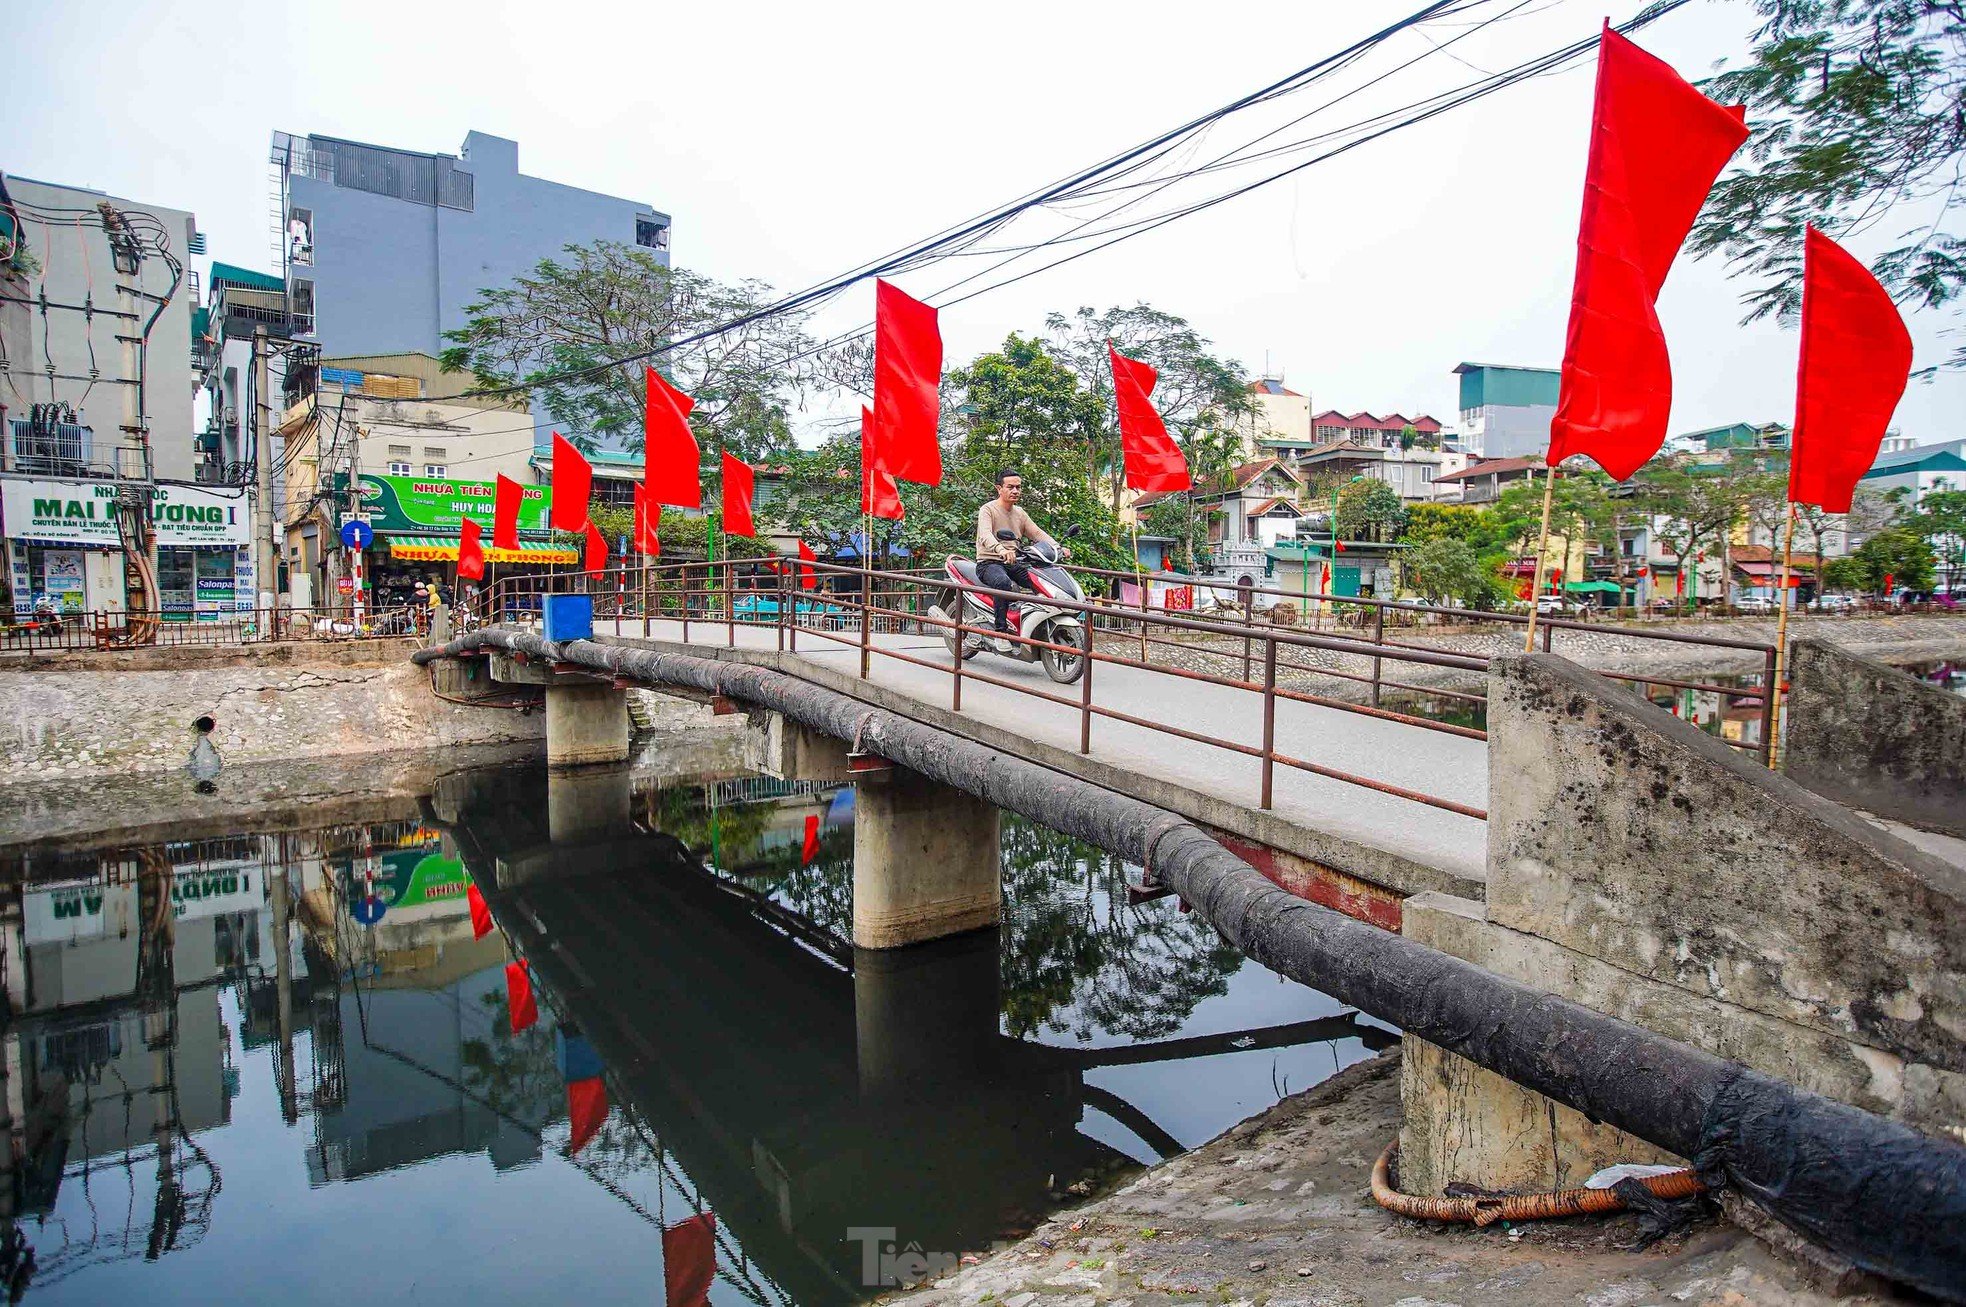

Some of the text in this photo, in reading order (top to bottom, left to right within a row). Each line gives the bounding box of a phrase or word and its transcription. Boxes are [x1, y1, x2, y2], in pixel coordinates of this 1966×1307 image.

[413, 482, 493, 497] NHỰA TIỀN
[33, 498, 95, 519] MAI
[452, 502, 474, 513] HUY
[32, 519, 61, 527] CHUYÊN
[89, 520, 112, 529] THUỐC
[191, 522, 214, 532] CHUẨN
[394, 550, 450, 560] NHỰA
[506, 554, 565, 563] PHONG
